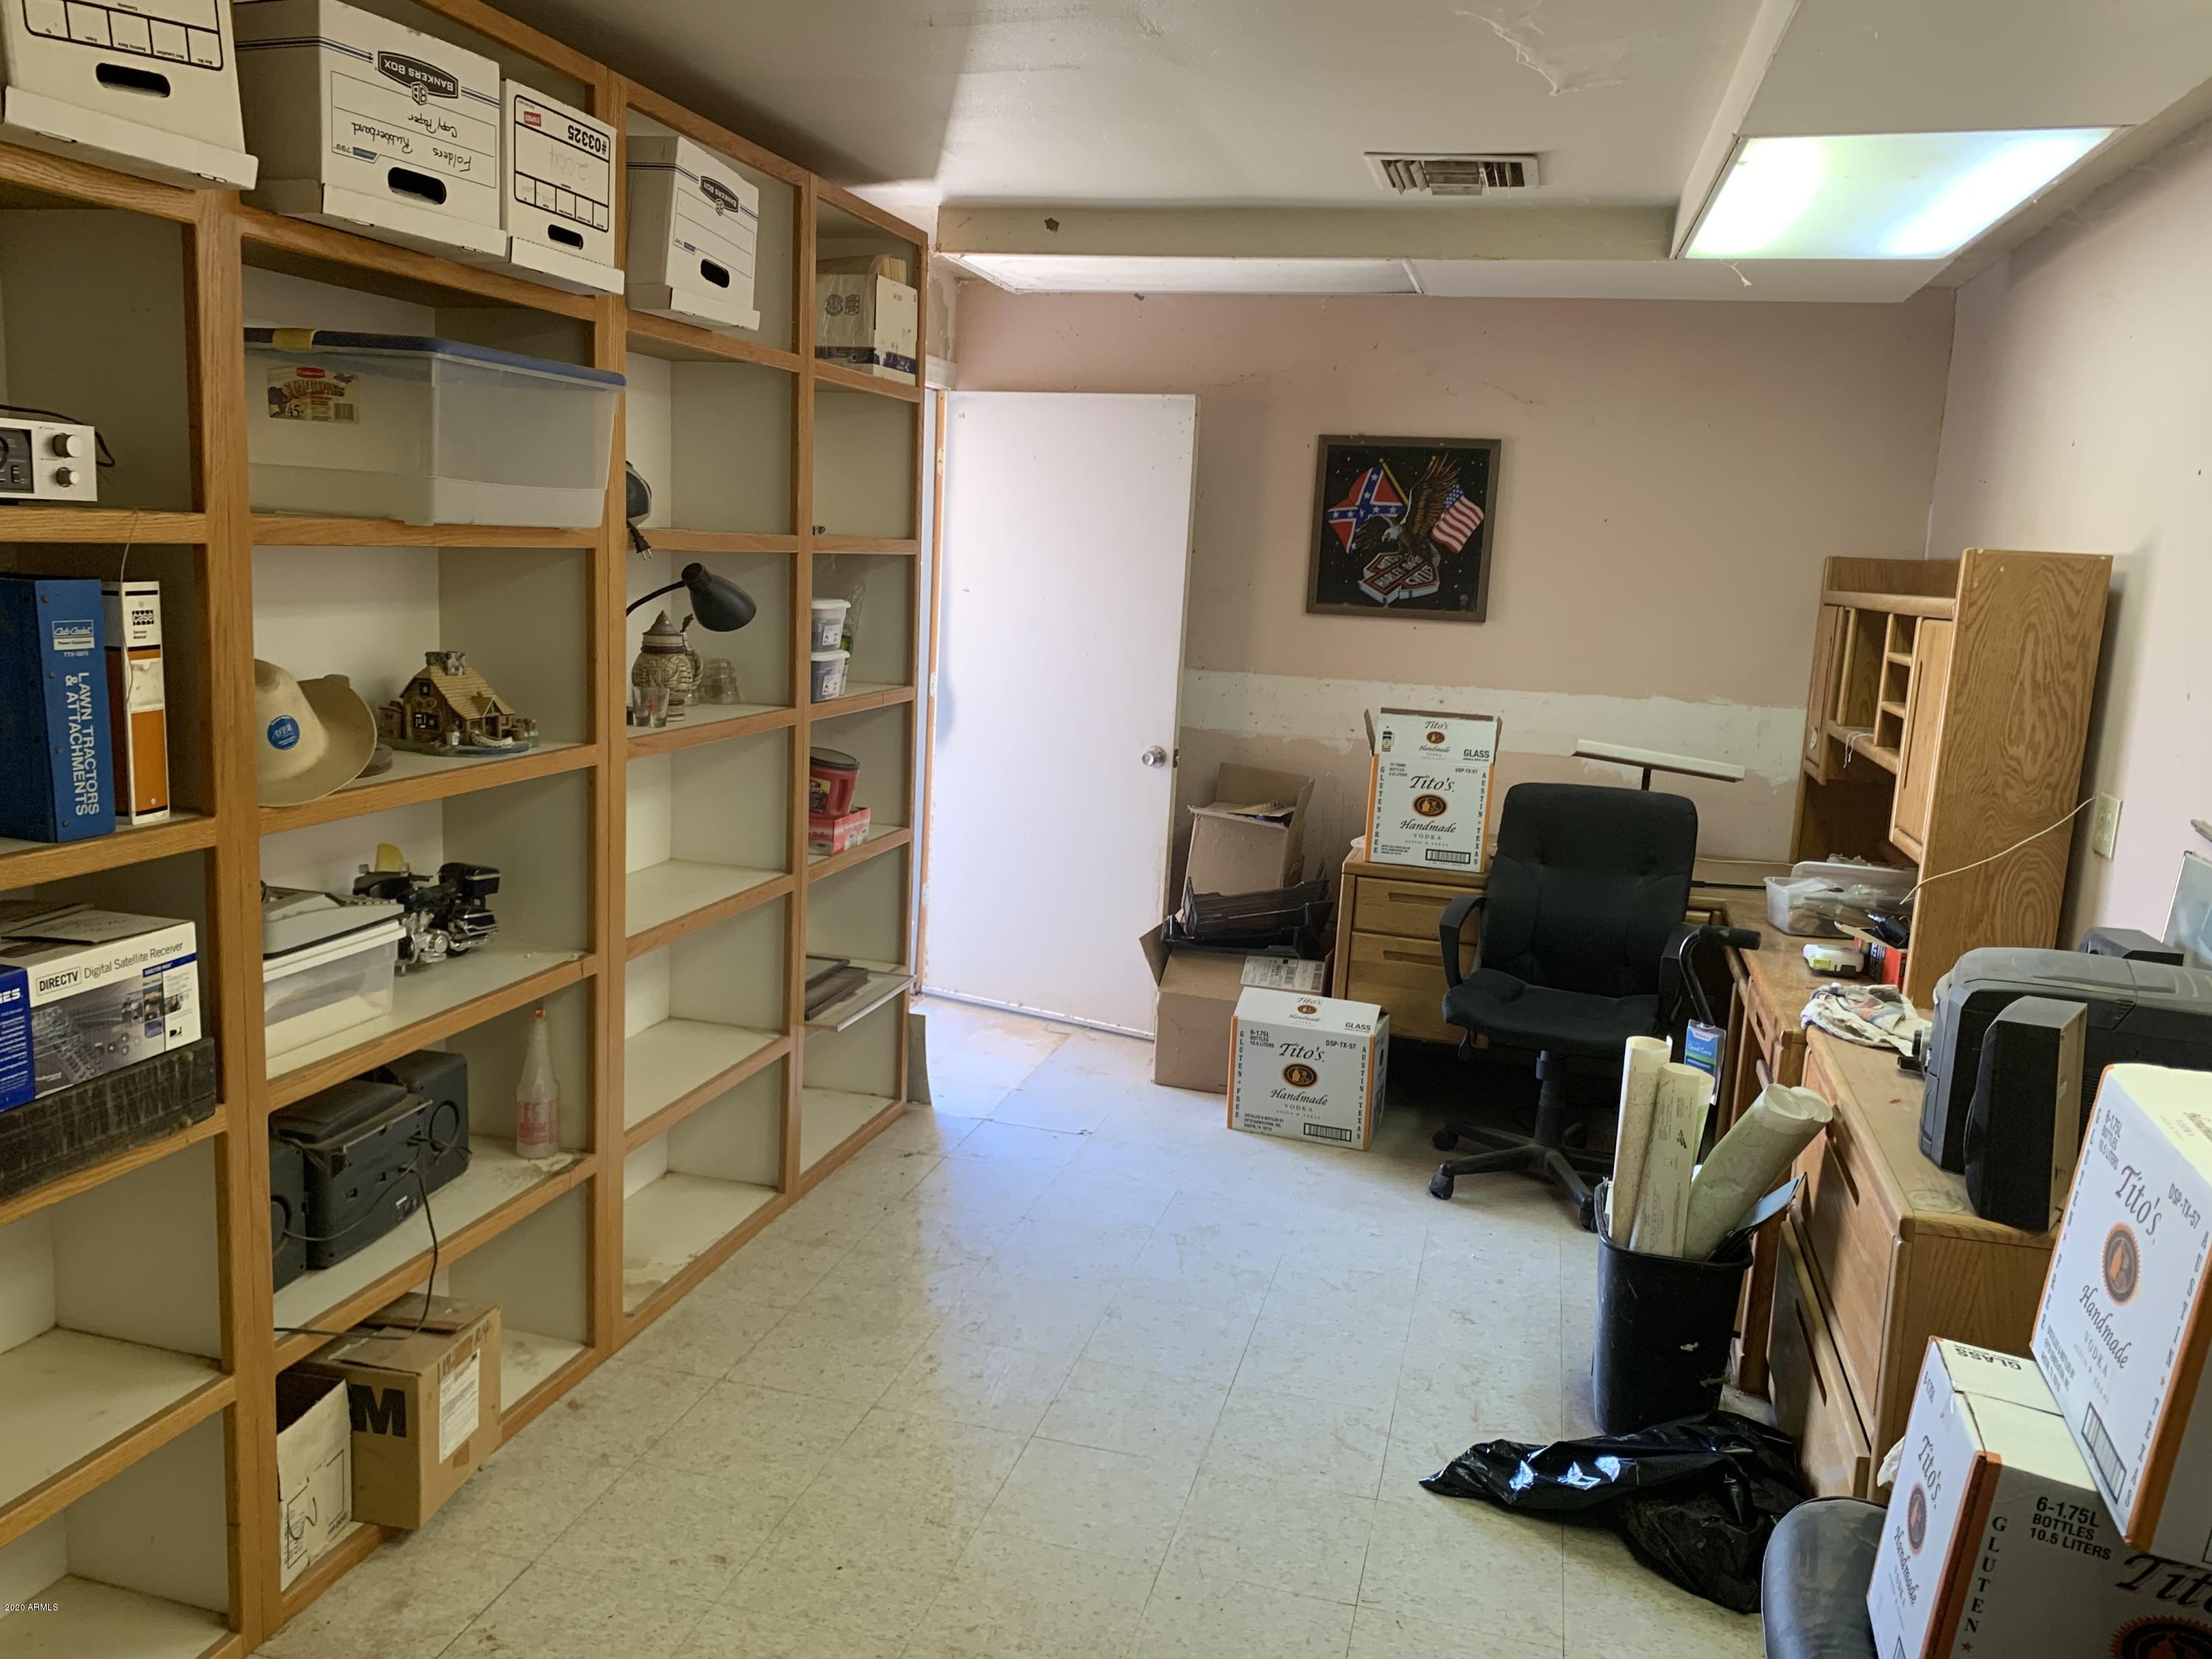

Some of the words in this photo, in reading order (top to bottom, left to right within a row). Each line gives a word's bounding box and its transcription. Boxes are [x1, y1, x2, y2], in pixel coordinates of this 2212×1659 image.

[383, 58, 406, 74] BOX
[408, 67, 453, 91] BANKERS
[407, 112, 437, 134] Paper
[437, 116, 458, 138] Copy
[351, 122, 413, 154] Rubberband
[567, 124, 608, 156] #03325
[432, 147, 473, 173] Folders
[703, 181, 714, 193] BOX
[714, 188, 737, 208] BANKERS
[65, 675, 78, 686] &
[78, 672, 93, 720] LAWN
[1425, 720, 1448, 730] Tito's
[66, 692, 88, 815] ATTACHMENTS
[1419, 745, 1451, 753] Handmade
[1464, 748, 1489, 759] GLASS
[82, 725, 100, 815] TRACTORS
[1409, 775, 1455, 792] Tito's
[1477, 772, 1486, 818] AUSTIN
[1399, 818, 1457, 833] Handmade
[1473, 827, 1481, 865] TEXAS
[39, 970, 80, 992] DIRECTV
[84, 961, 112, 979] Digital
[114, 952, 149, 971] Satellite
[150, 942, 184, 959] Receiver
[1296, 996, 1322, 1006] Tito's
[1344, 1022, 1371, 1032] GLASS
[1279, 1042, 1325, 1062] Tito's
[1326, 1040, 1357, 1049] DSP-TX-57
[1270, 1088, 1328, 1106] Handmade
[1284, 1102, 1313, 1113] VODKA
[2104, 1109, 2124, 1138] 6-1.75L
[2067, 1108, 2101, 1227] GLUTEN
[2115, 1165, 2162, 1236] Tito's
[2168, 1183, 2201, 1229] DSP-TX-57
[2165, 1231, 2209, 1368] AUSTIN
[2079, 1285, 2132, 1369] Handmade
[1955, 1348, 2023, 1371] GLASS
[2084, 1331, 2108, 1378] VODKA
[2124, 1397, 2160, 1508] TEXAS
[1917, 1434, 1942, 1502] Tito's
[2036, 1496, 2100, 1528] 6-1.75L
[2031, 1513, 2096, 1542] BOTTLES
[2029, 1527, 2059, 1545] 10.5
[2062, 1536, 2112, 1561] LITERS
[1893, 1525, 1916, 1609] Handmade
[1964, 1515, 2008, 1634] GLUTEN
[2115, 1553, 2212, 1613] Tit
